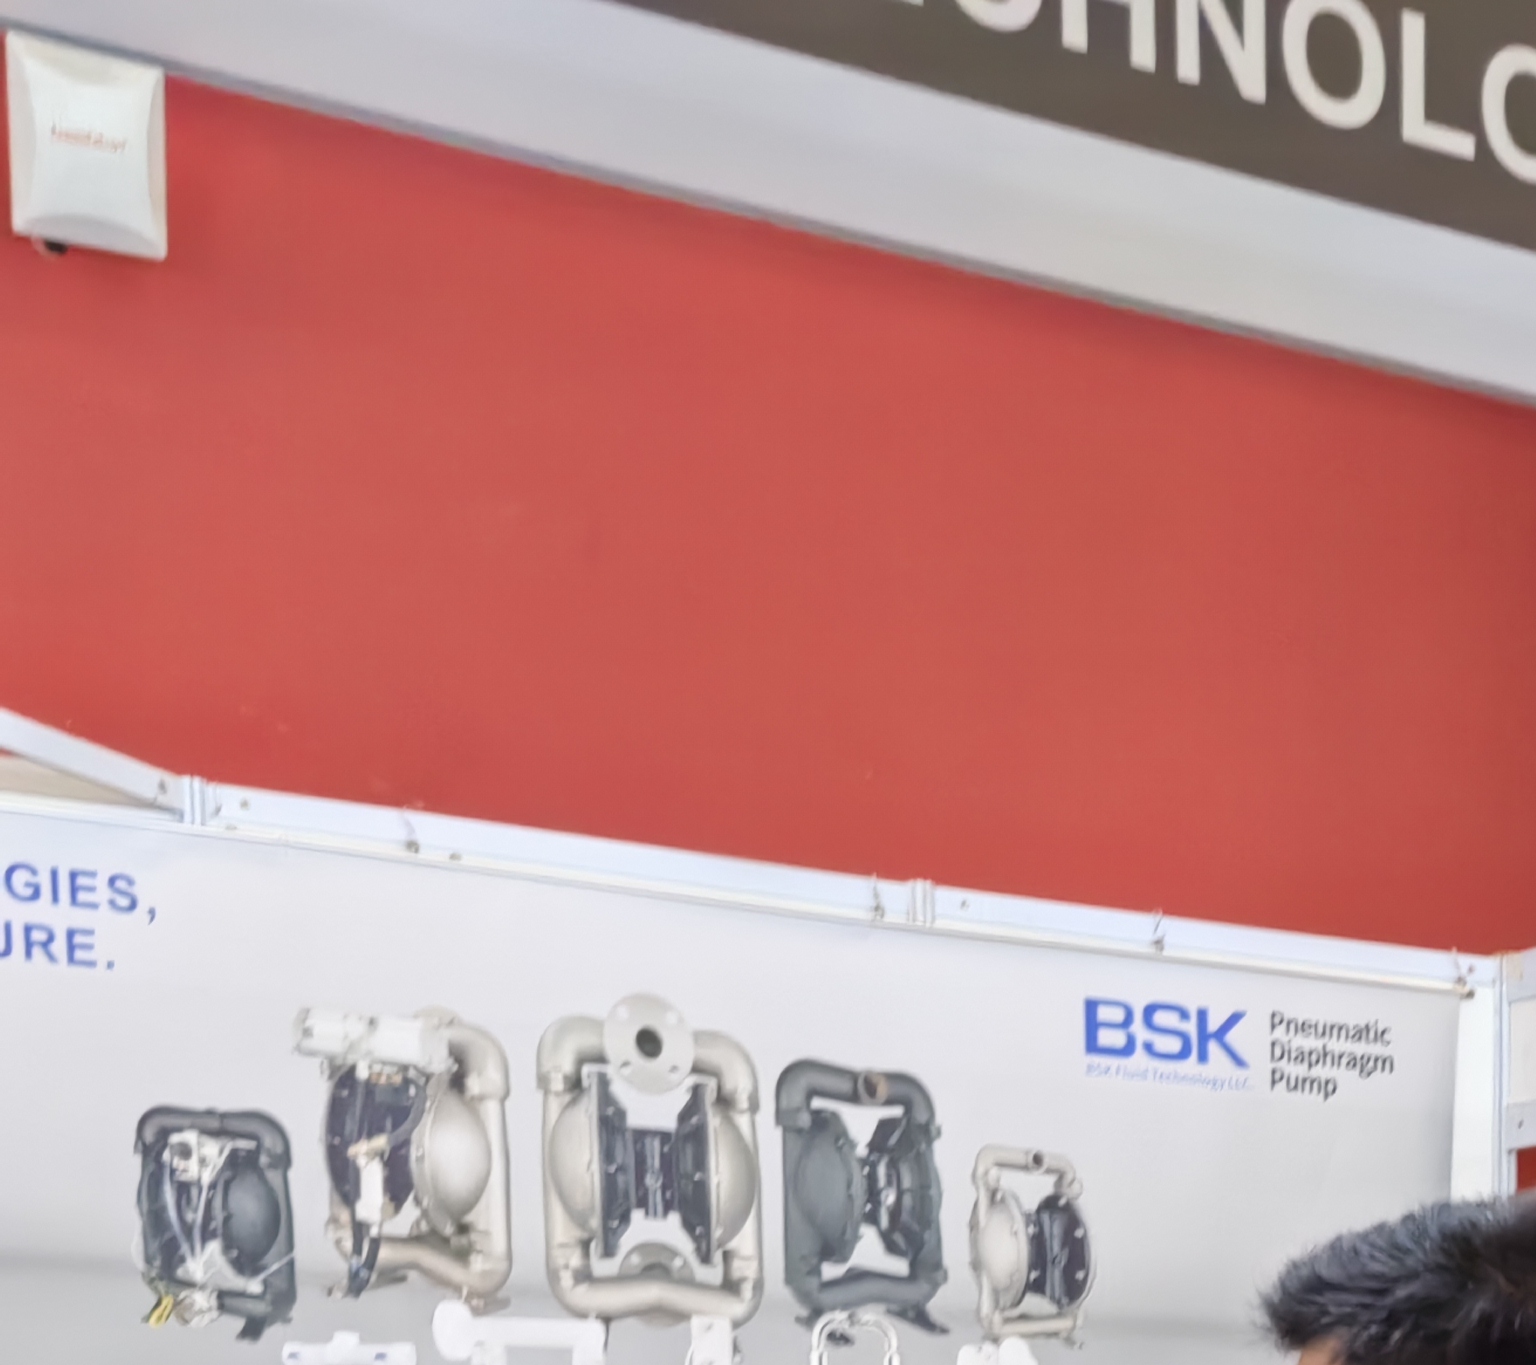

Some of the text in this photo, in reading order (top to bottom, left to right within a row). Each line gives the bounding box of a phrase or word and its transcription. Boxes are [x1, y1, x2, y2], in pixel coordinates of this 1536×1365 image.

[3, 862, 157, 926] GIES,
[1084, 997, 1250, 1069] BSK
[1269, 1010, 1393, 1048] Pneumatic
[1269, 1040, 1395, 1080] Diaphragm
[1269, 1066, 1339, 1102] Pump
